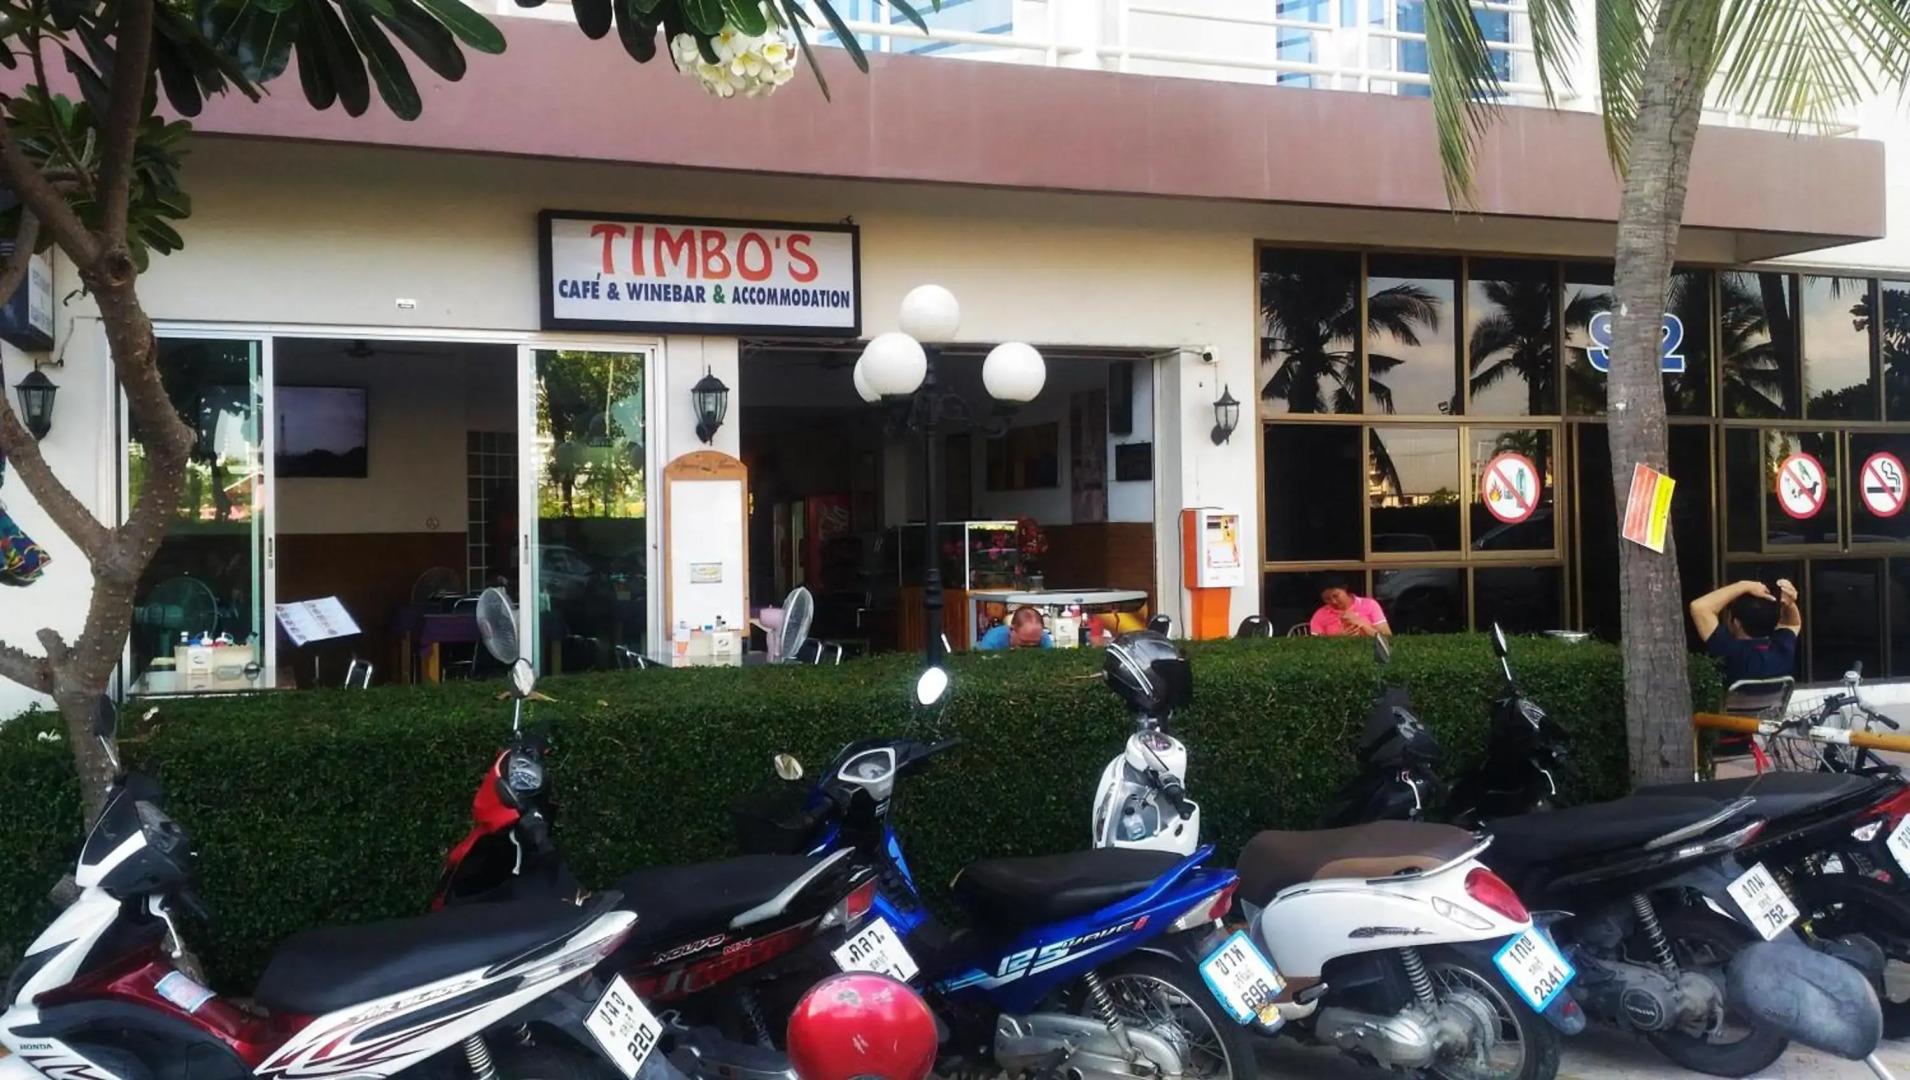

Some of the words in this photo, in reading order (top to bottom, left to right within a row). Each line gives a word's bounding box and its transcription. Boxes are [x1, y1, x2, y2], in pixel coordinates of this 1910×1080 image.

[590, 223, 819, 283] TIMBO'S
[557, 273, 601, 300] CAFÉ
[606, 281, 620, 301] &
[625, 282, 707, 304] WINEBAR
[712, 284, 727, 304] &
[731, 286, 850, 309] ACCOMMODATION
[1763, 904, 1788, 928] 752
[654, 934, 725, 965] NOUVO
[997, 937, 1077, 977] 125
[1241, 977, 1271, 1010] 696
[1534, 965, 1566, 1001] 2341
[20, 1043, 53, 1051] HONDA
[627, 1023, 654, 1062] 220
